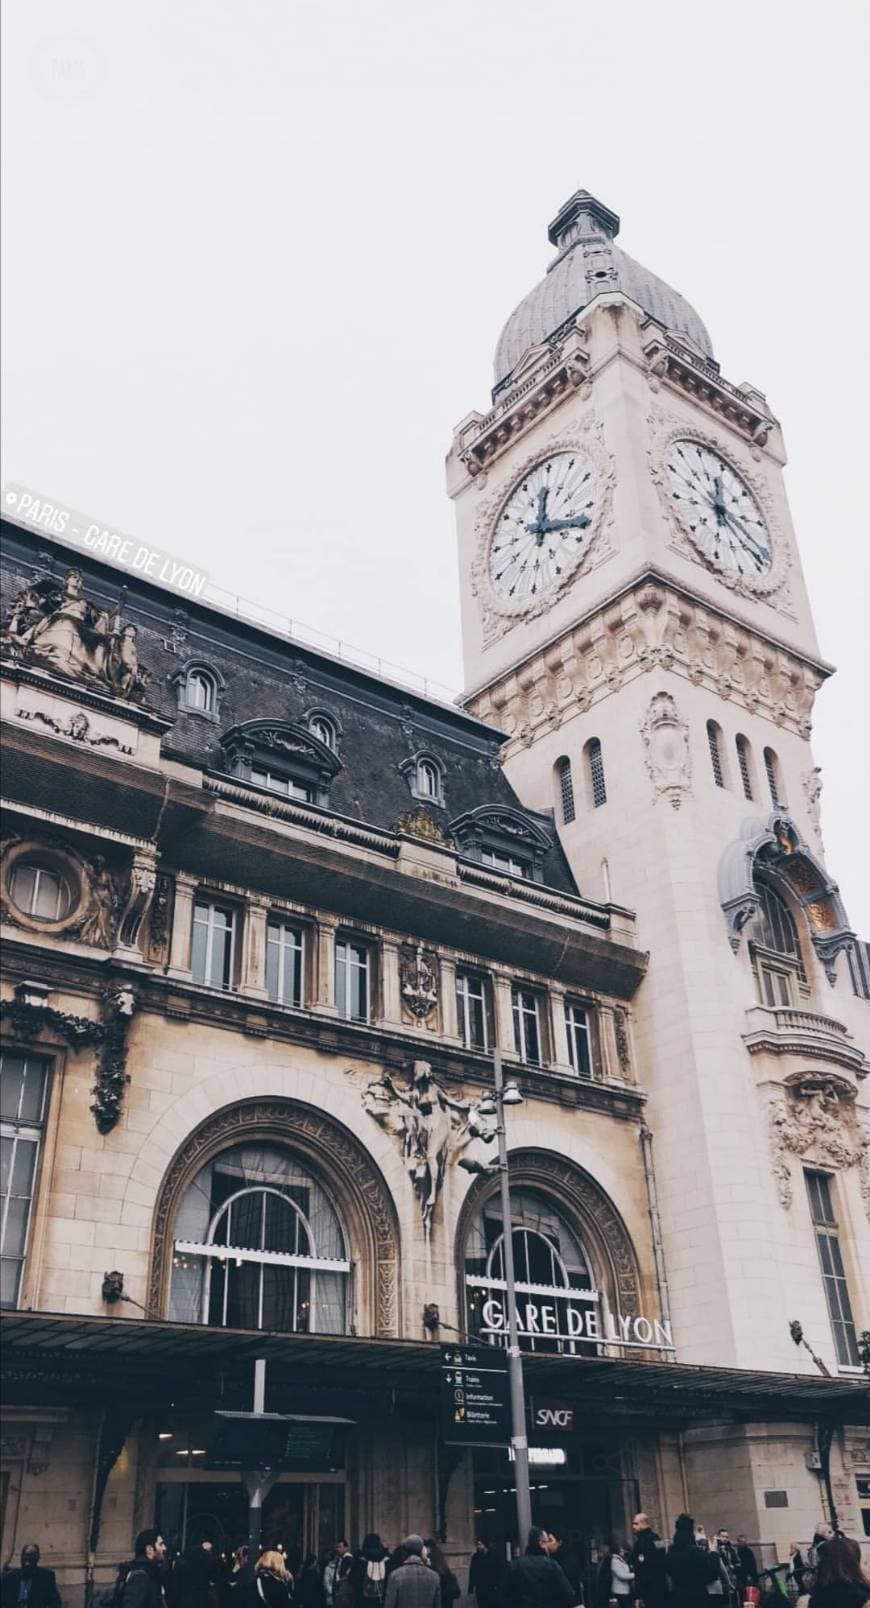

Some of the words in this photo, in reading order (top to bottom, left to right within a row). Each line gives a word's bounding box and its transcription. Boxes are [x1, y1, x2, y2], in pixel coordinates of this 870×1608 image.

[566, 1308, 599, 1338] DE
[609, 1313, 673, 1345] LYON
[466, 1393, 494, 1401] Information
[535, 1408, 574, 1427] SNCF
